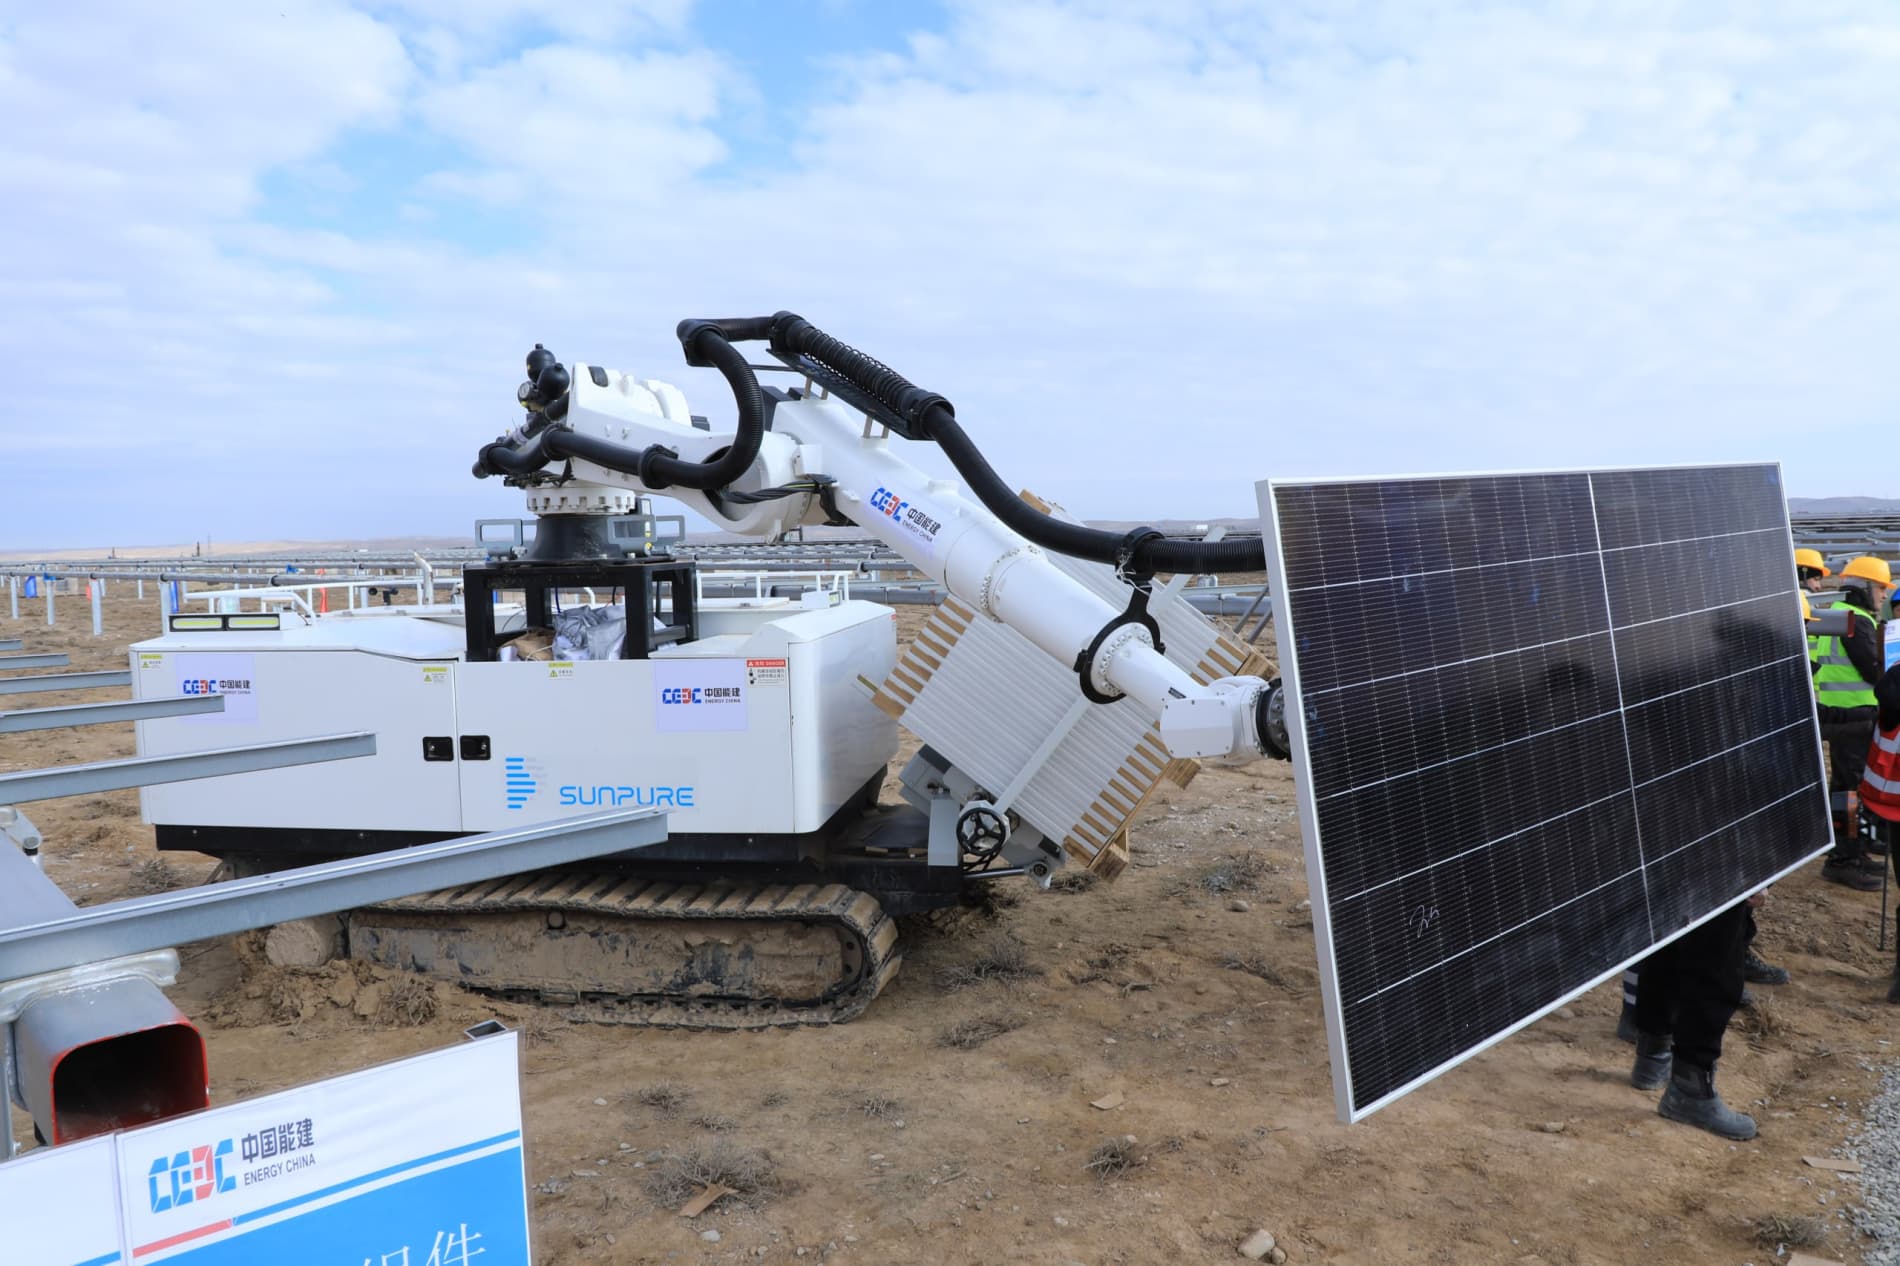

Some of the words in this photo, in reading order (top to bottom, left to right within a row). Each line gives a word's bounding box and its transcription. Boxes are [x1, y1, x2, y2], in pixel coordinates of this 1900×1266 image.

[907, 508, 941, 536] 中国能建
[219, 680, 250, 689] 中国能建
[704, 687, 740, 698] 中国能建
[559, 785, 695, 807] SUNPURE
[241, 1118, 315, 1164] 中国能建
[243, 1163, 284, 1187] ENERGY
[285, 1152, 317, 1173] CHINA
